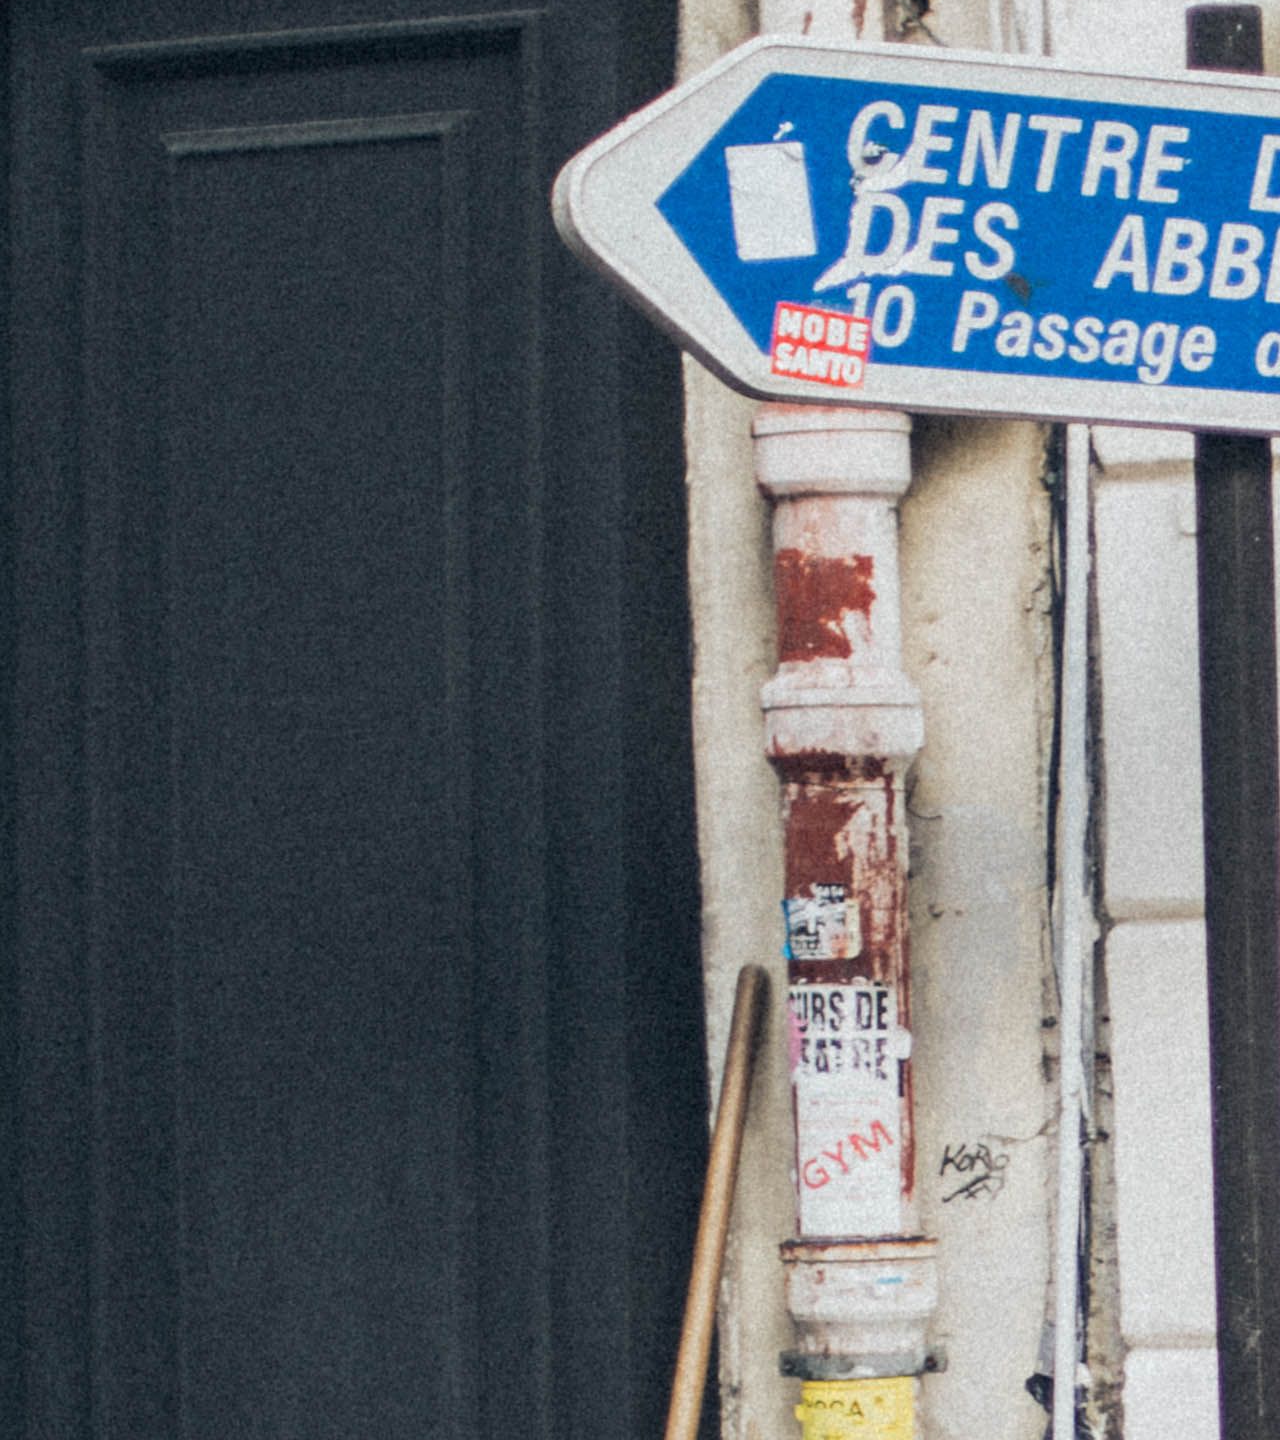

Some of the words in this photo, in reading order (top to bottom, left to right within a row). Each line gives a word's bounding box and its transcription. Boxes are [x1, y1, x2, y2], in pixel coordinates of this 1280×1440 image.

[847, 100, 1191, 203] CENTRE
[849, 193, 1021, 281] DES
[775, 343, 863, 384] SANTO
[778, 308, 868, 352] MOBE
[846, 283, 915, 349] 10
[952, 290, 1217, 384] Passage
[802, 1120, 894, 1190] GYM
